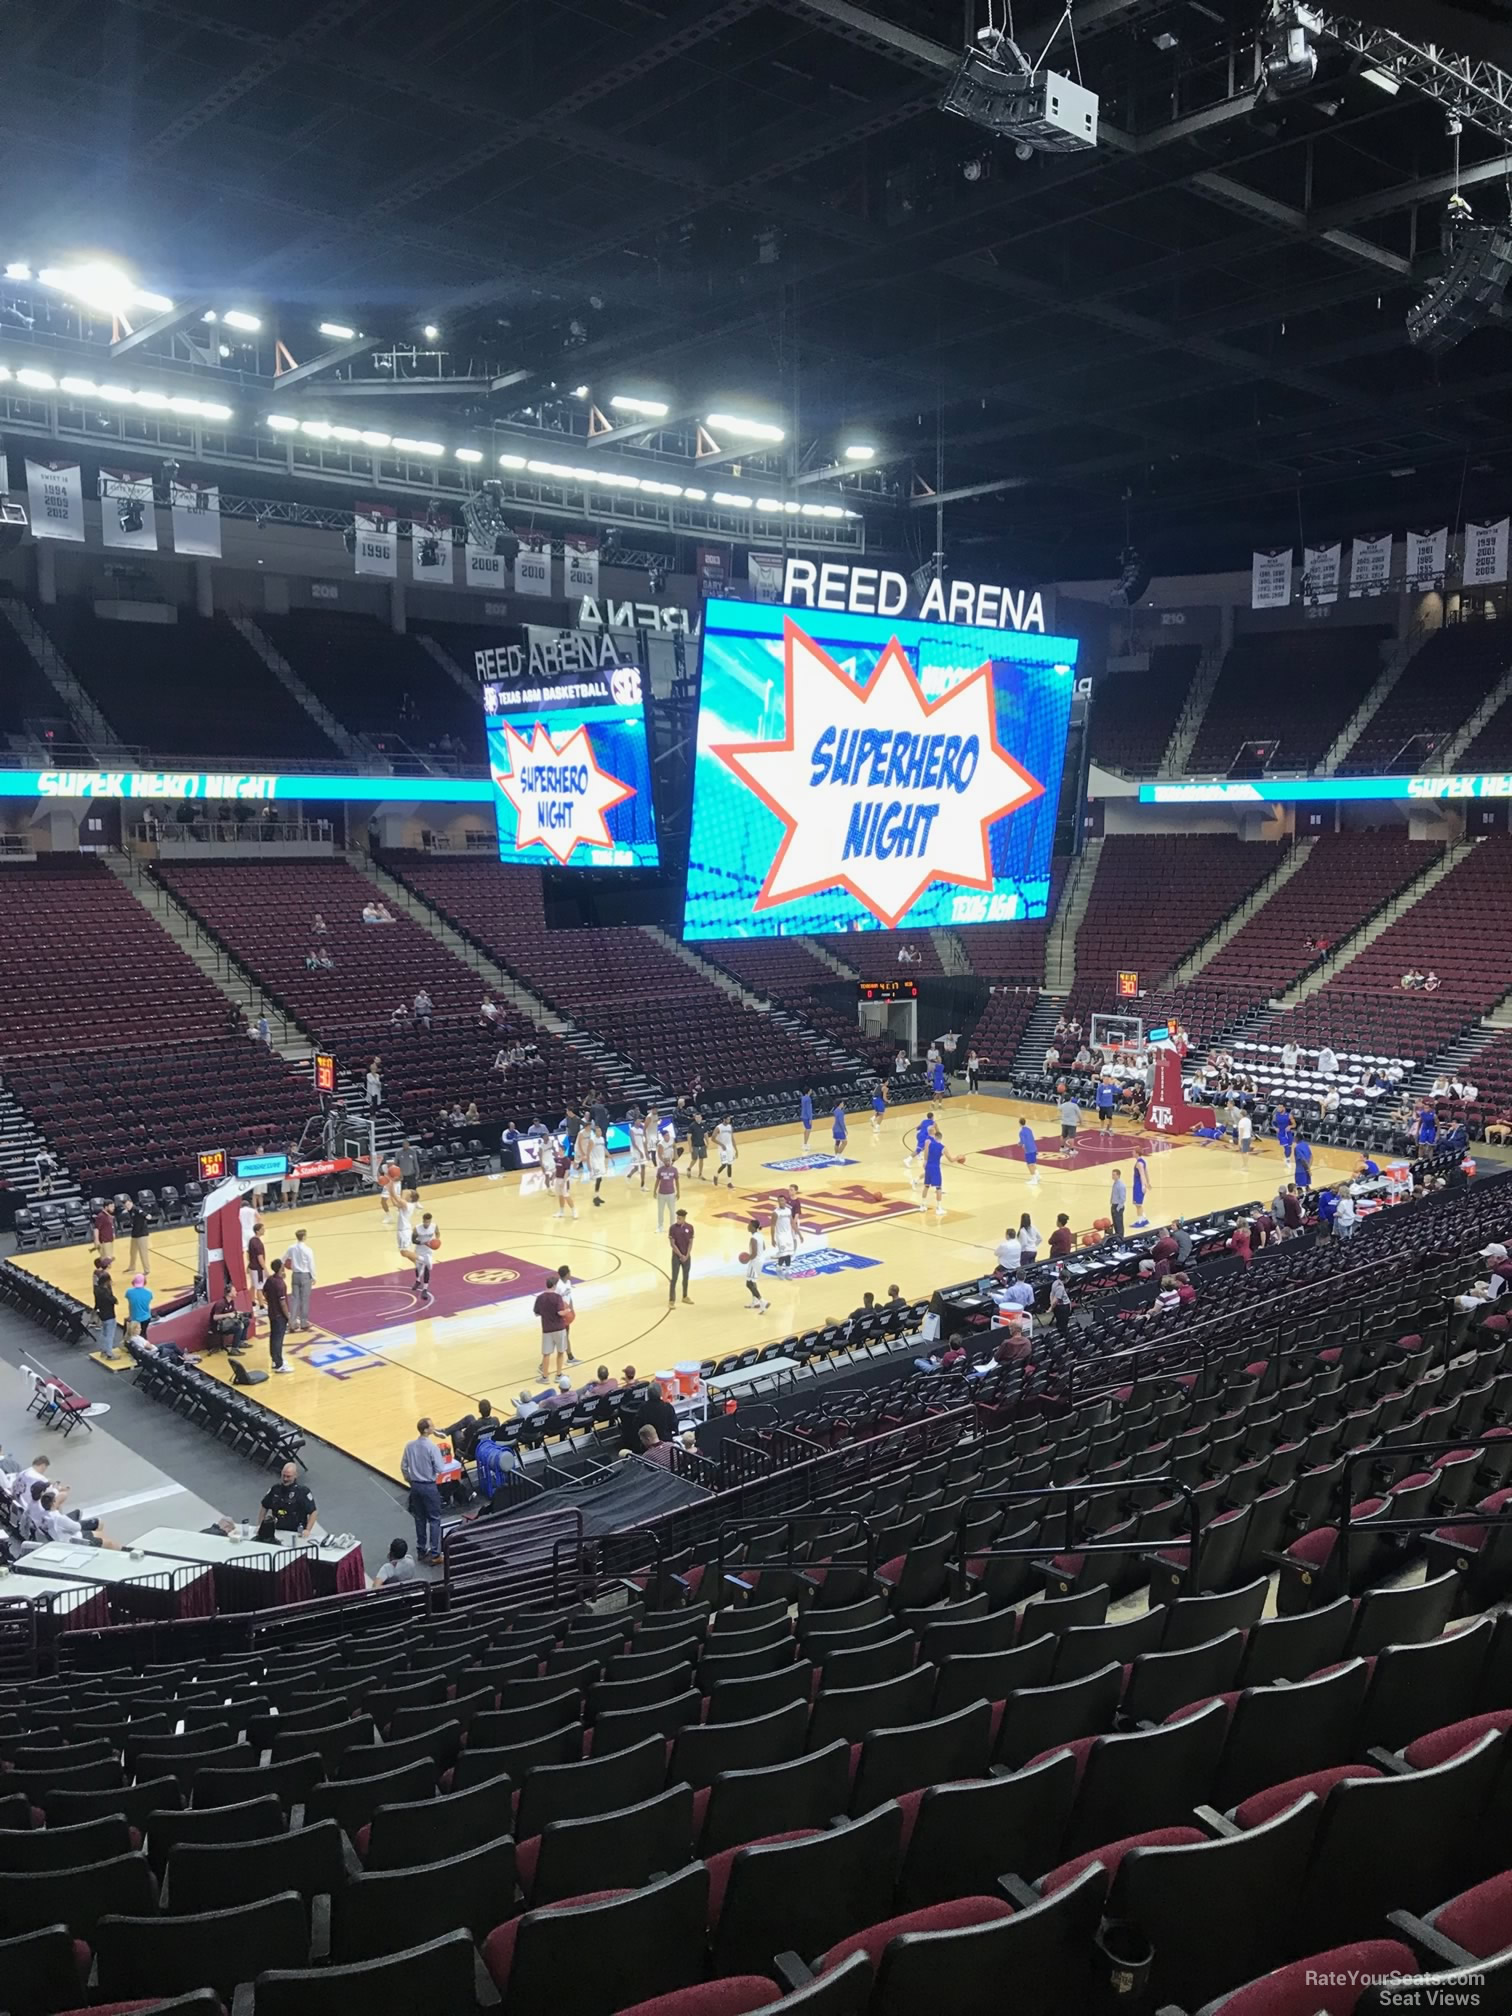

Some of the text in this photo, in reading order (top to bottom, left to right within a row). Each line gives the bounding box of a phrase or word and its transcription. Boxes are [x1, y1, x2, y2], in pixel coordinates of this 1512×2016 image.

[44, 484, 67, 496] 1994
[46, 507, 69, 519] 2012
[362, 543, 390, 559] 1996
[472, 557, 499, 572] 2008
[521, 564, 545, 580] 2010
[783, 558, 1046, 633] REED ARENA
[474, 633, 620, 681] REED ARENA
[499, 691, 521, 705] TEXAS
[543, 682, 608, 701] BASKETBALL
[809, 725, 980, 794] SUPERHERO
[37, 772, 279, 799] SUPER HERO NIGHT
[520, 763, 589, 796] SUPERHERO
[1407, 777, 1476, 798] SUPER
[537, 800, 574, 829] NIGHT
[841, 800, 940, 861] NIGHT
[1122, 981, 1134, 993] 30
[319, 1068, 330, 1087] 30
[205, 1163, 219, 1174] 30
